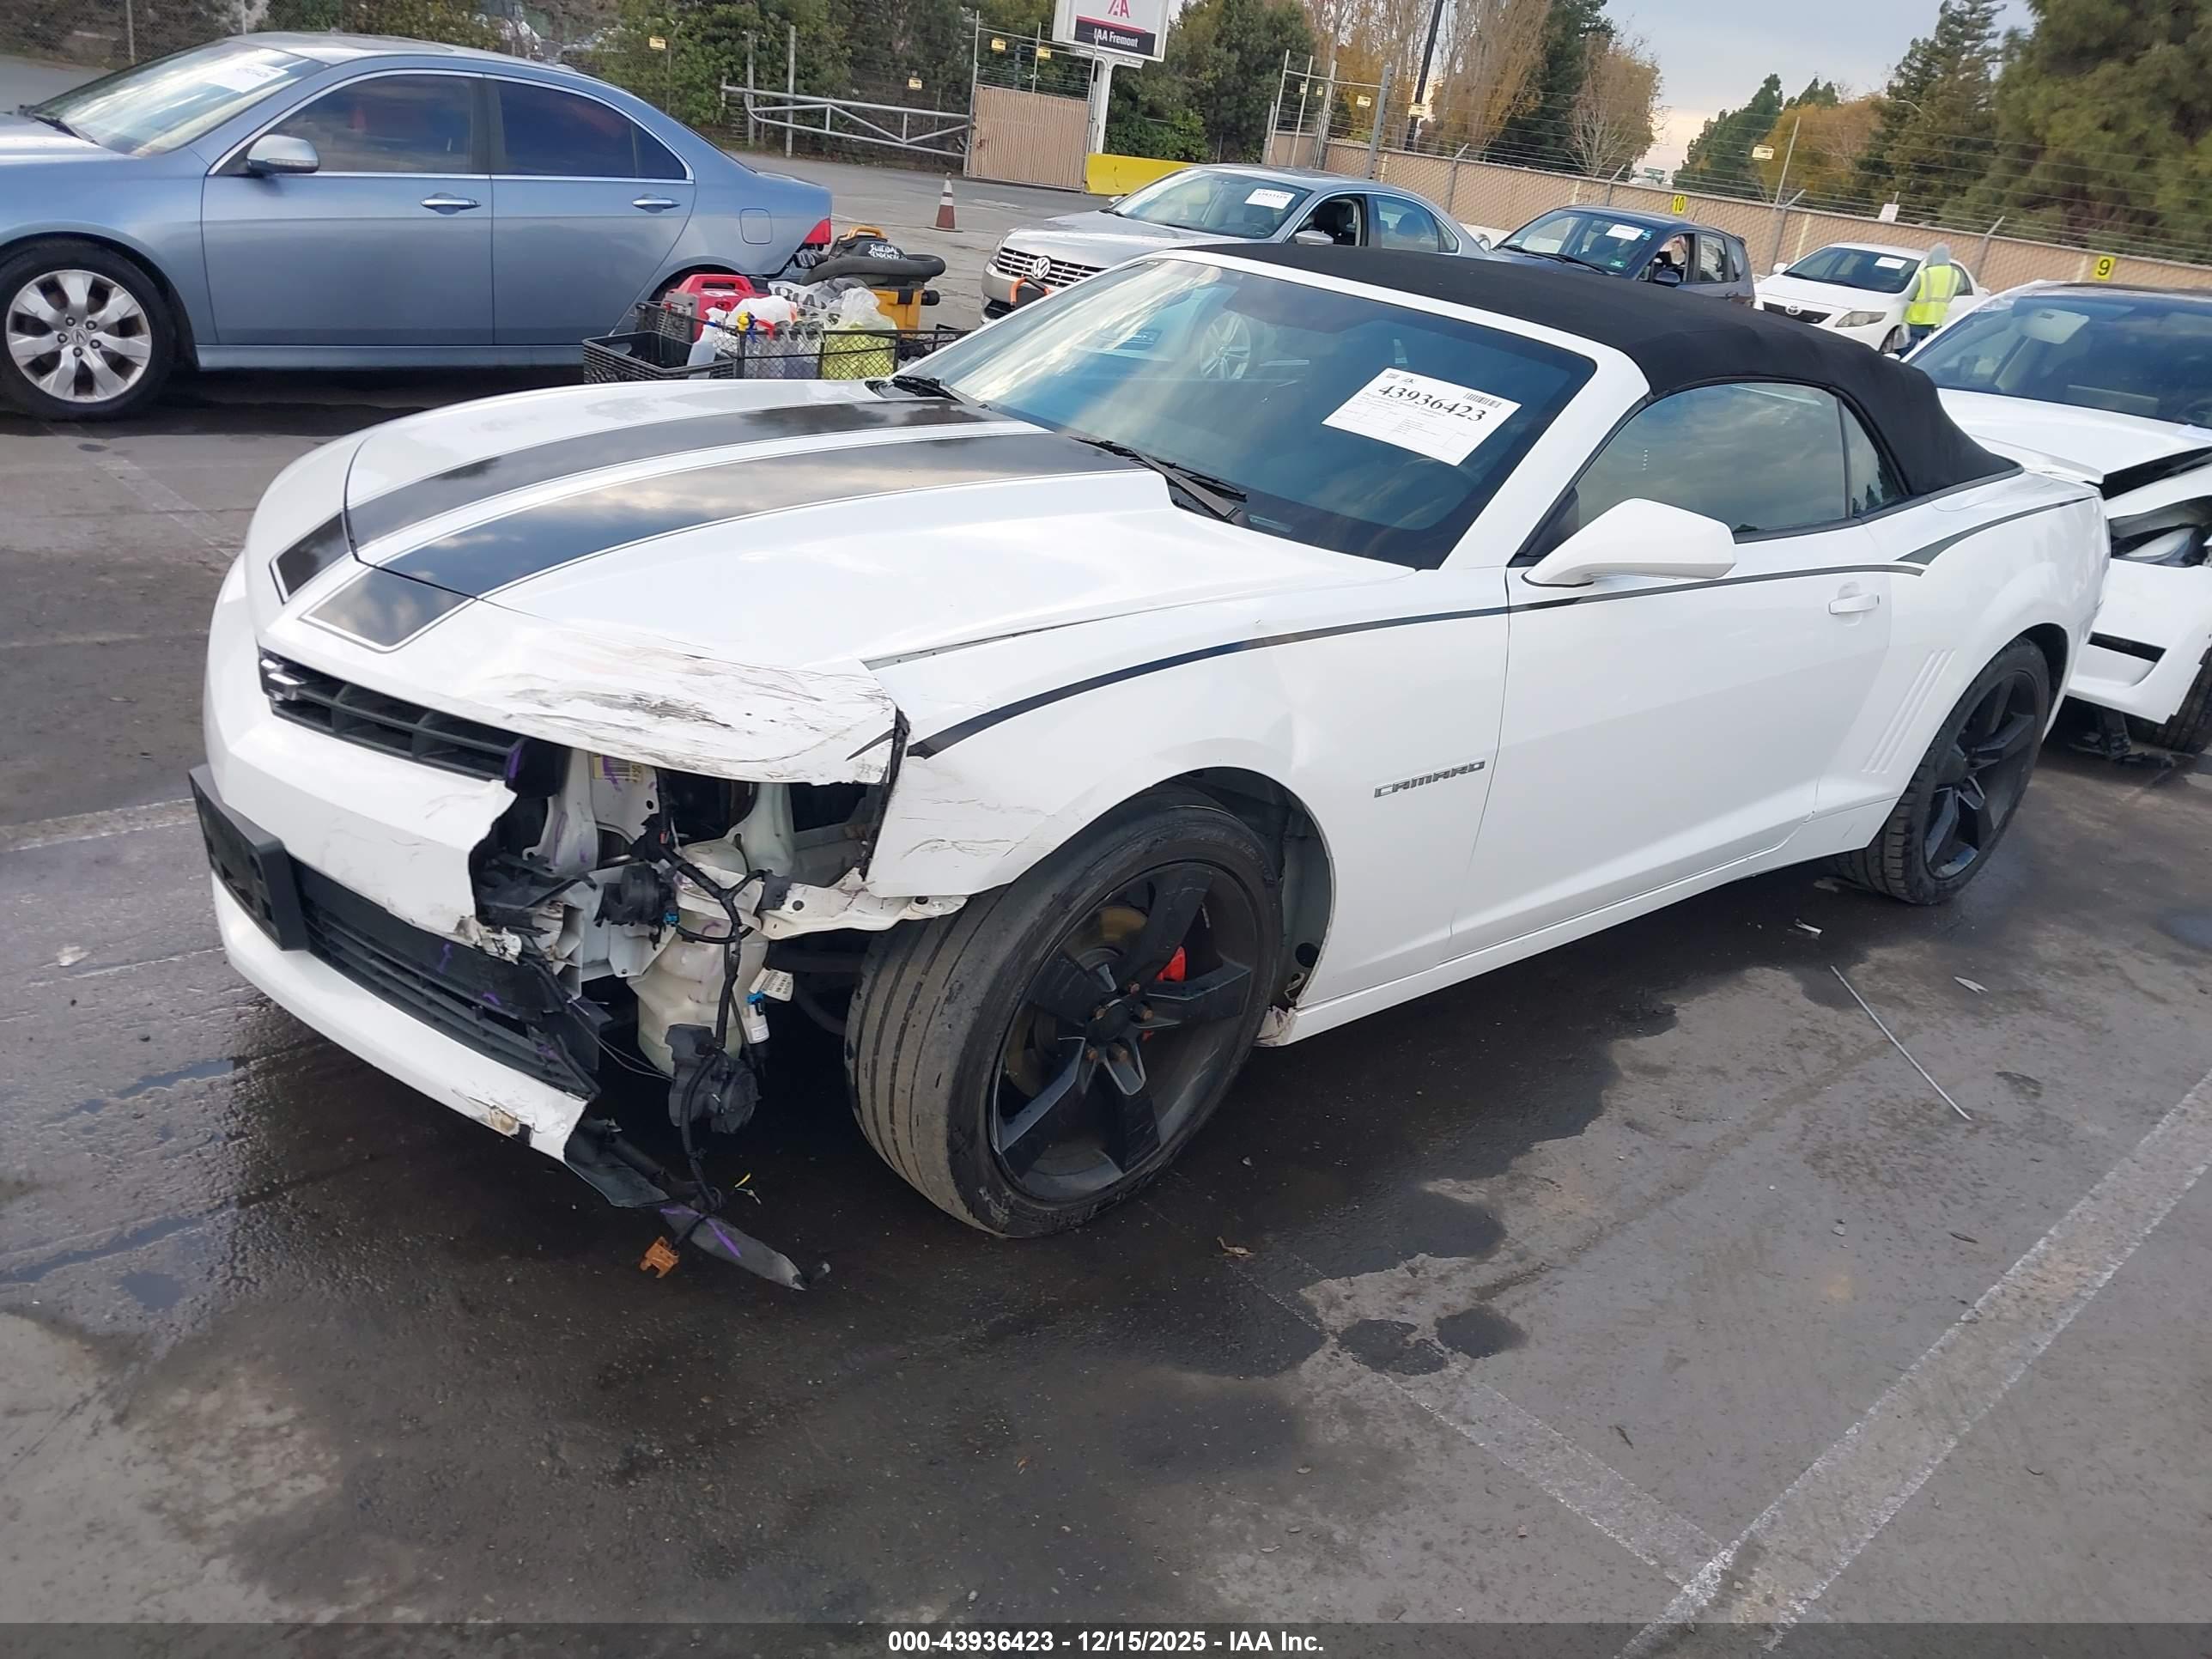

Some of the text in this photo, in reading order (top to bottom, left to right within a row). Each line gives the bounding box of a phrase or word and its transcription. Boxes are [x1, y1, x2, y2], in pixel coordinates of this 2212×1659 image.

[1093, 27, 1139, 47] IAA Fremont
[1674, 197, 1684, 211] 10
[2098, 259, 2111, 276] 9
[1378, 386, 1486, 421] 43936423
[1374, 759, 1485, 798] CAMARO
